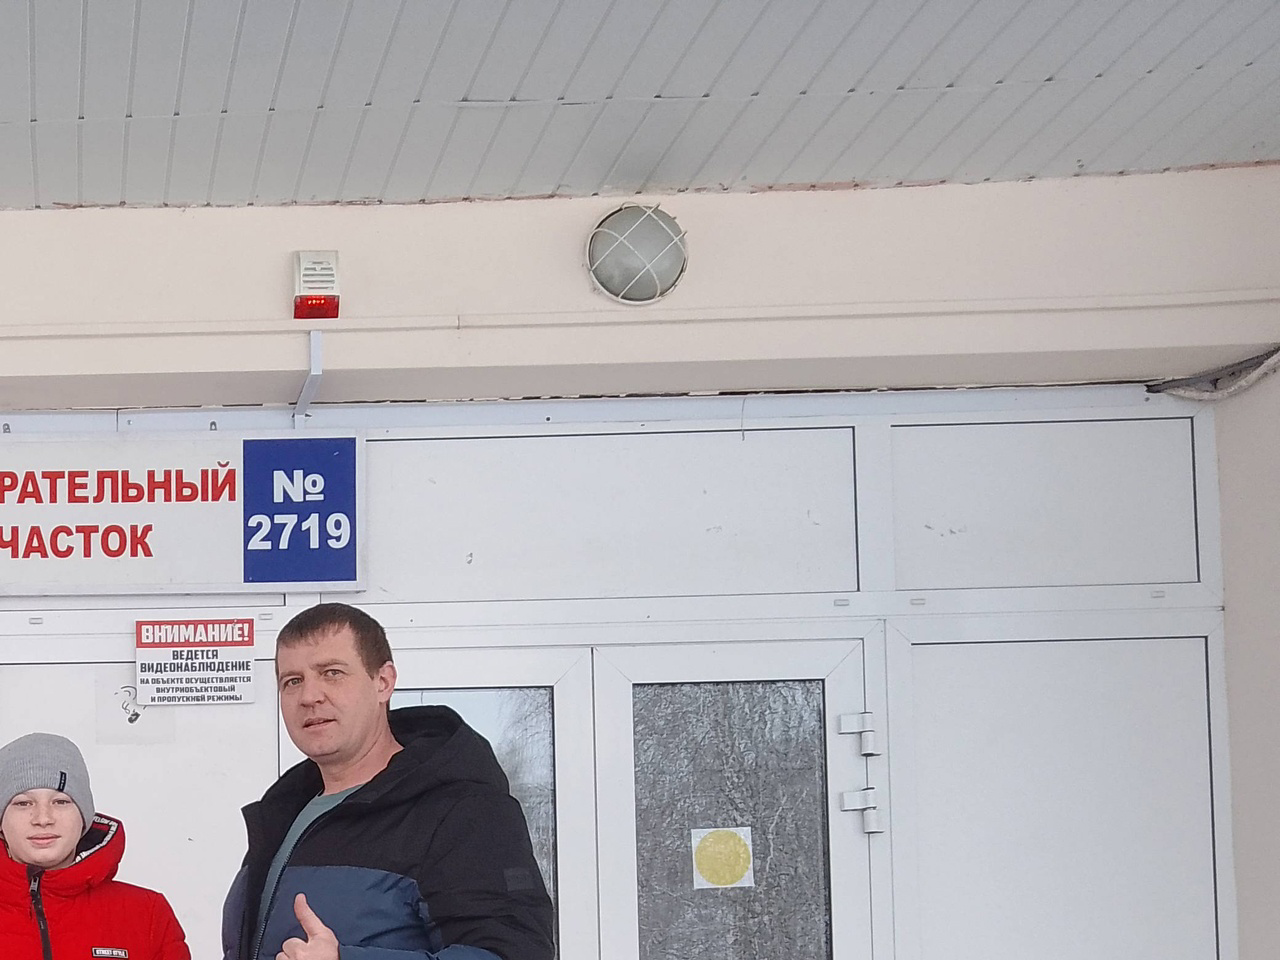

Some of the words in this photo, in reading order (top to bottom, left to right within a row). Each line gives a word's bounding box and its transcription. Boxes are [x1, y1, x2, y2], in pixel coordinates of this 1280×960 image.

[272, 469, 325, 503] №
[247, 513, 351, 550] 2719
[141, 623, 250, 643] ВНИМАНИЕ!
[172, 649, 219, 661] ВЕДЕТСЯ
[140, 661, 251, 674] ВИДЕОНАБЛЮДЕНИЕ
[140, 677, 150, 685] НА
[151, 677, 184, 685] ОБЪЕКТЕ
[185, 676, 252, 685] ОСУЩЕСТВЛЯЕТСЯ
[156, 685, 236, 694] ВНУТРИОБЪЕКТОВЫЙ
[207, 695, 243, 703] РЕЖИМЫ
